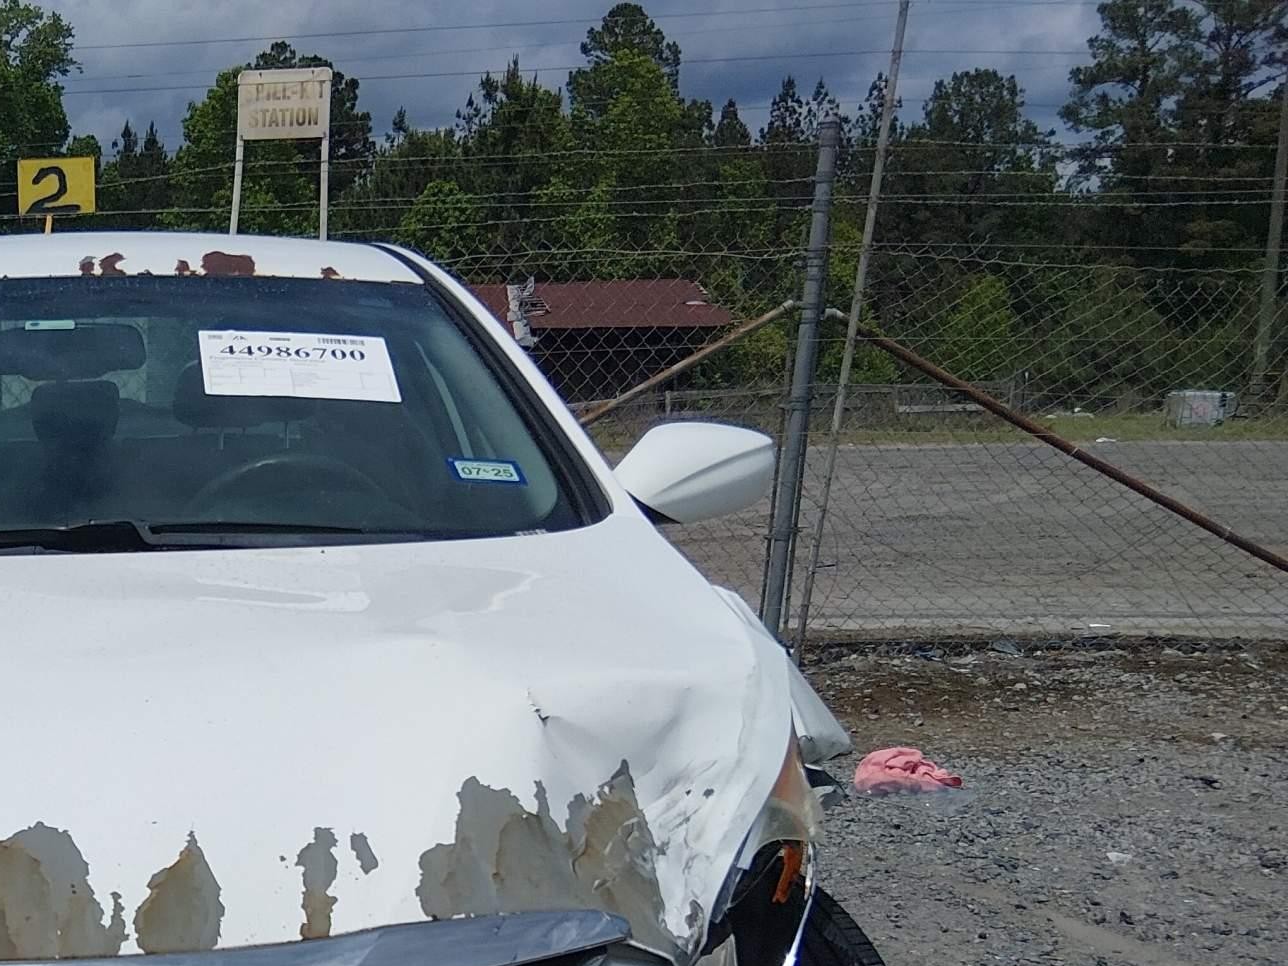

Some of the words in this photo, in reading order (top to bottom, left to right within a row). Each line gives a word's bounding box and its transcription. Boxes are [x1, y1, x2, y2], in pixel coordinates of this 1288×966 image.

[245, 81, 326, 101] PILL-KT
[248, 107, 319, 128] STATION
[26, 166, 81, 214] 2
[220, 344, 366, 362] 44986700
